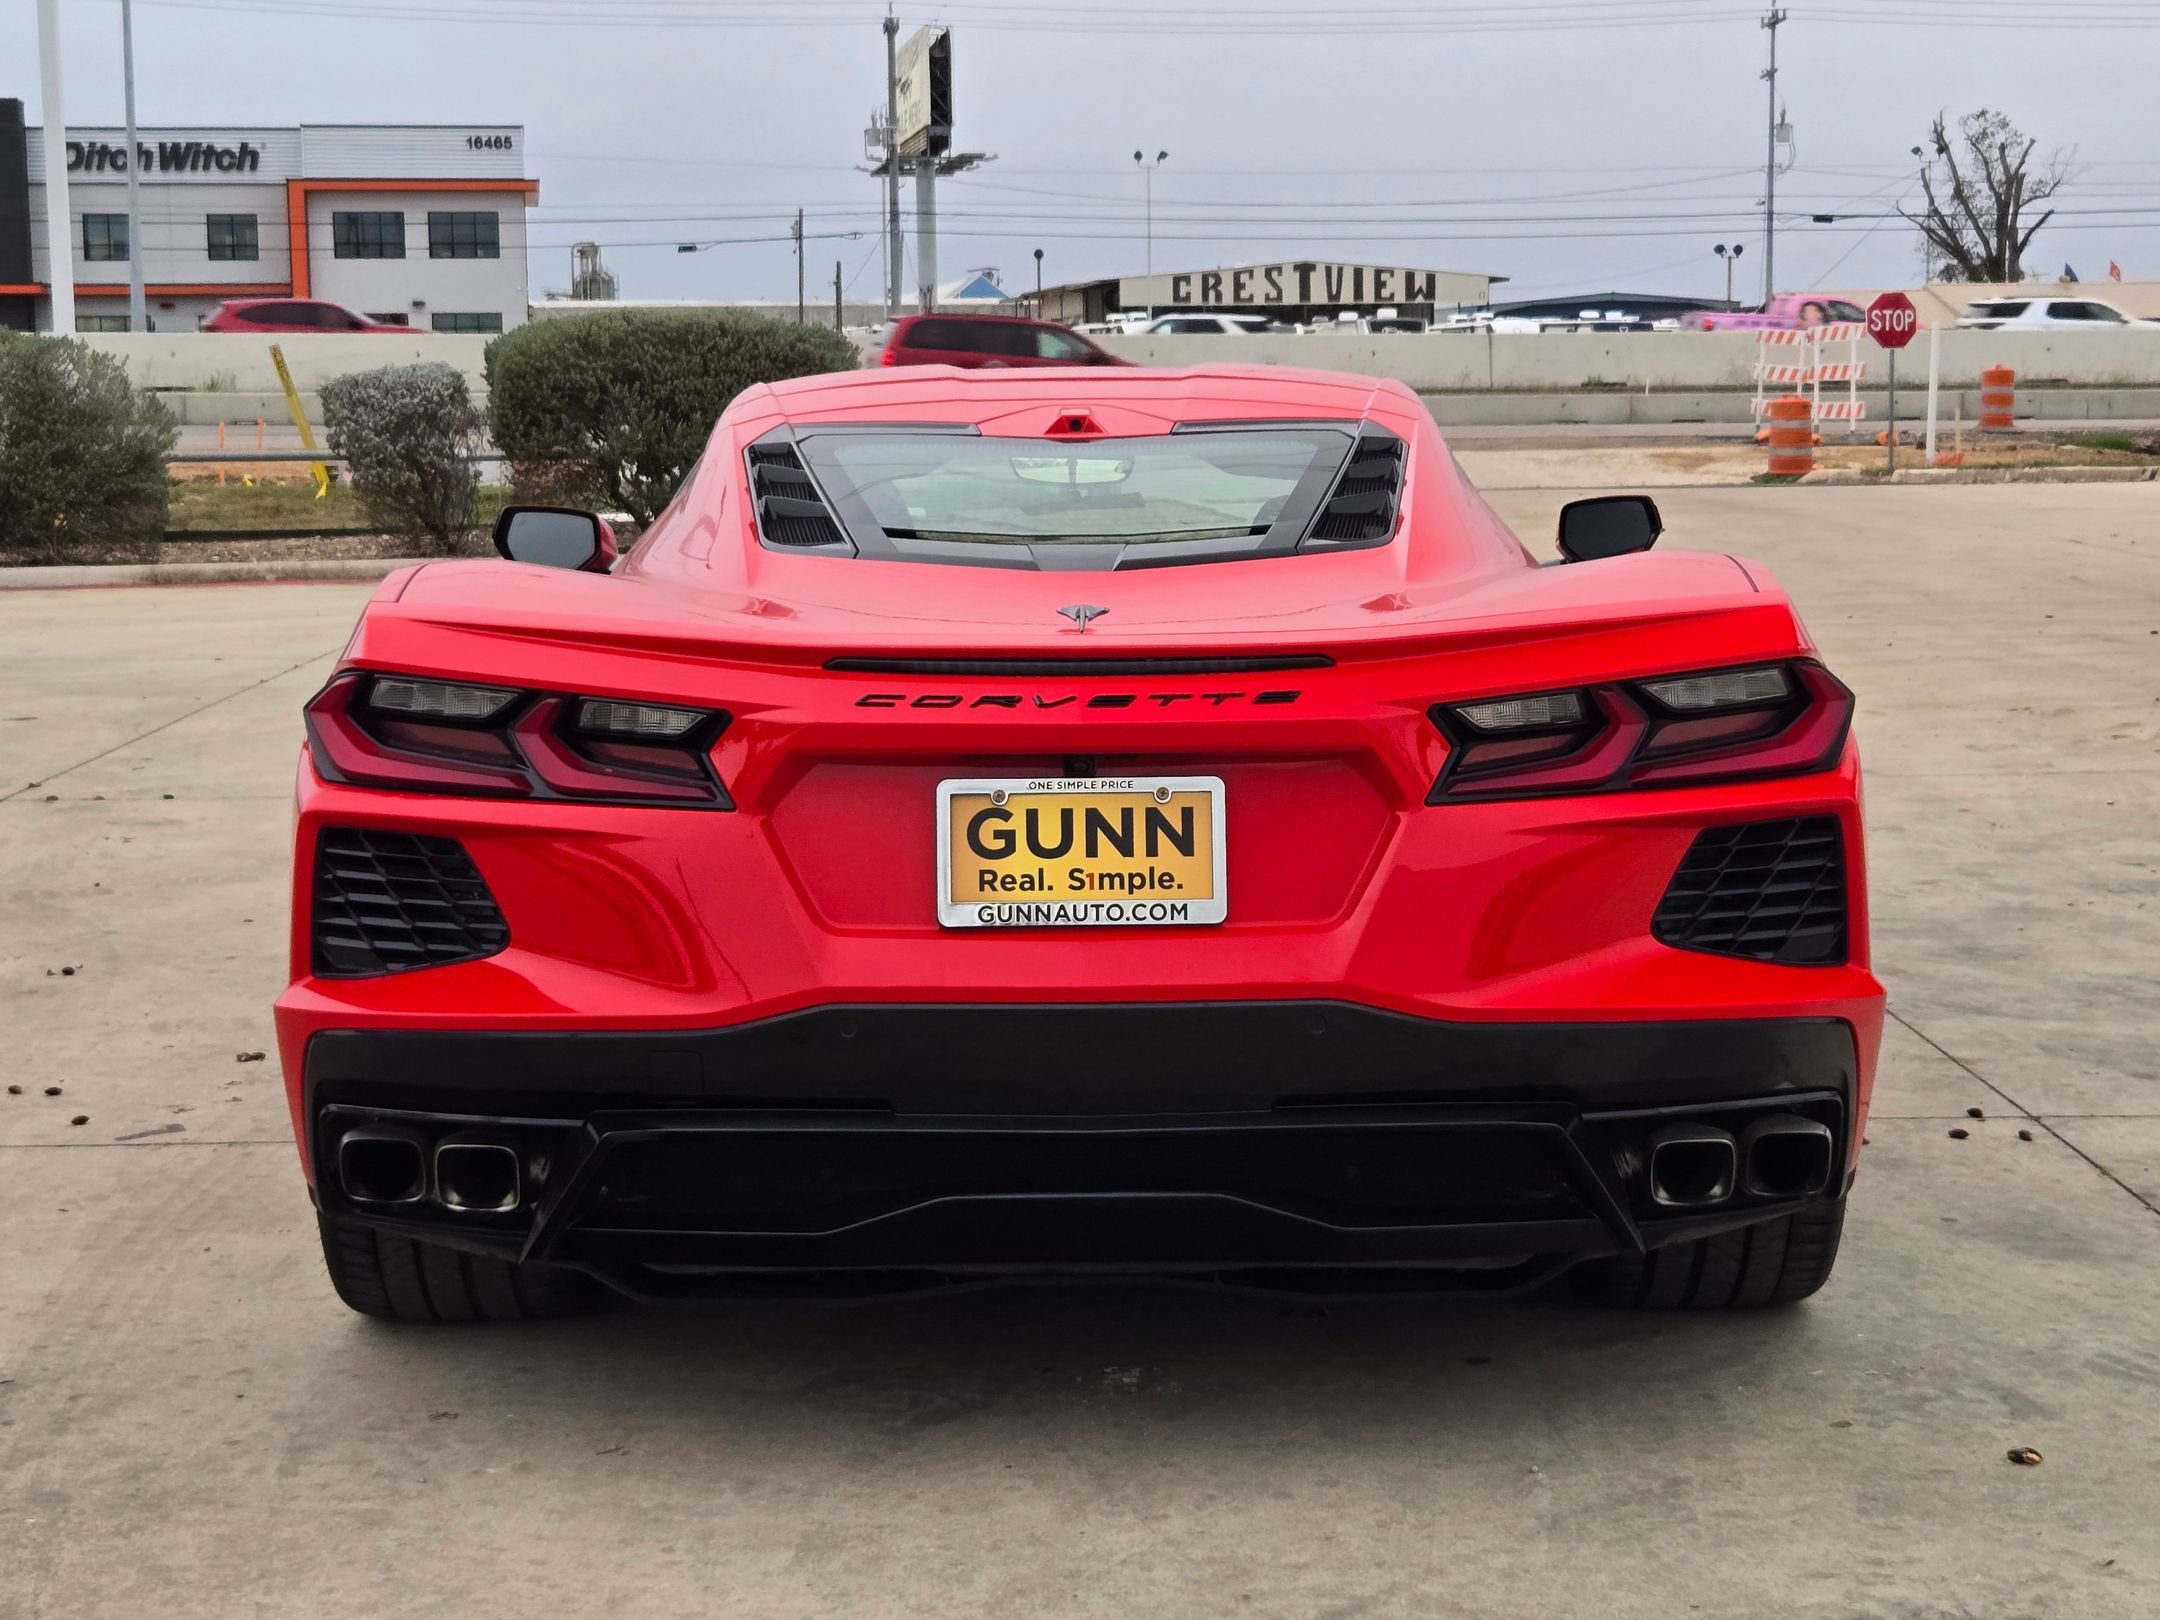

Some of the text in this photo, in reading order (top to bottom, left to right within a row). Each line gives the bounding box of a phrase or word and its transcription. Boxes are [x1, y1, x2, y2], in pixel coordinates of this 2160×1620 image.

[465, 135, 513, 150] 16465
[65, 141, 260, 171] Ditch Witch
[1172, 263, 1436, 303] CRESTVIEW
[1870, 309, 1915, 333] STOP
[854, 690, 1302, 709] CORVETTE
[1028, 780, 1135, 790] ONE SIMPLE PRICE
[966, 806, 1195, 860] GUNN
[978, 867, 1054, 892] Real.
[977, 903, 1189, 924] GUNNAUTO.COM
